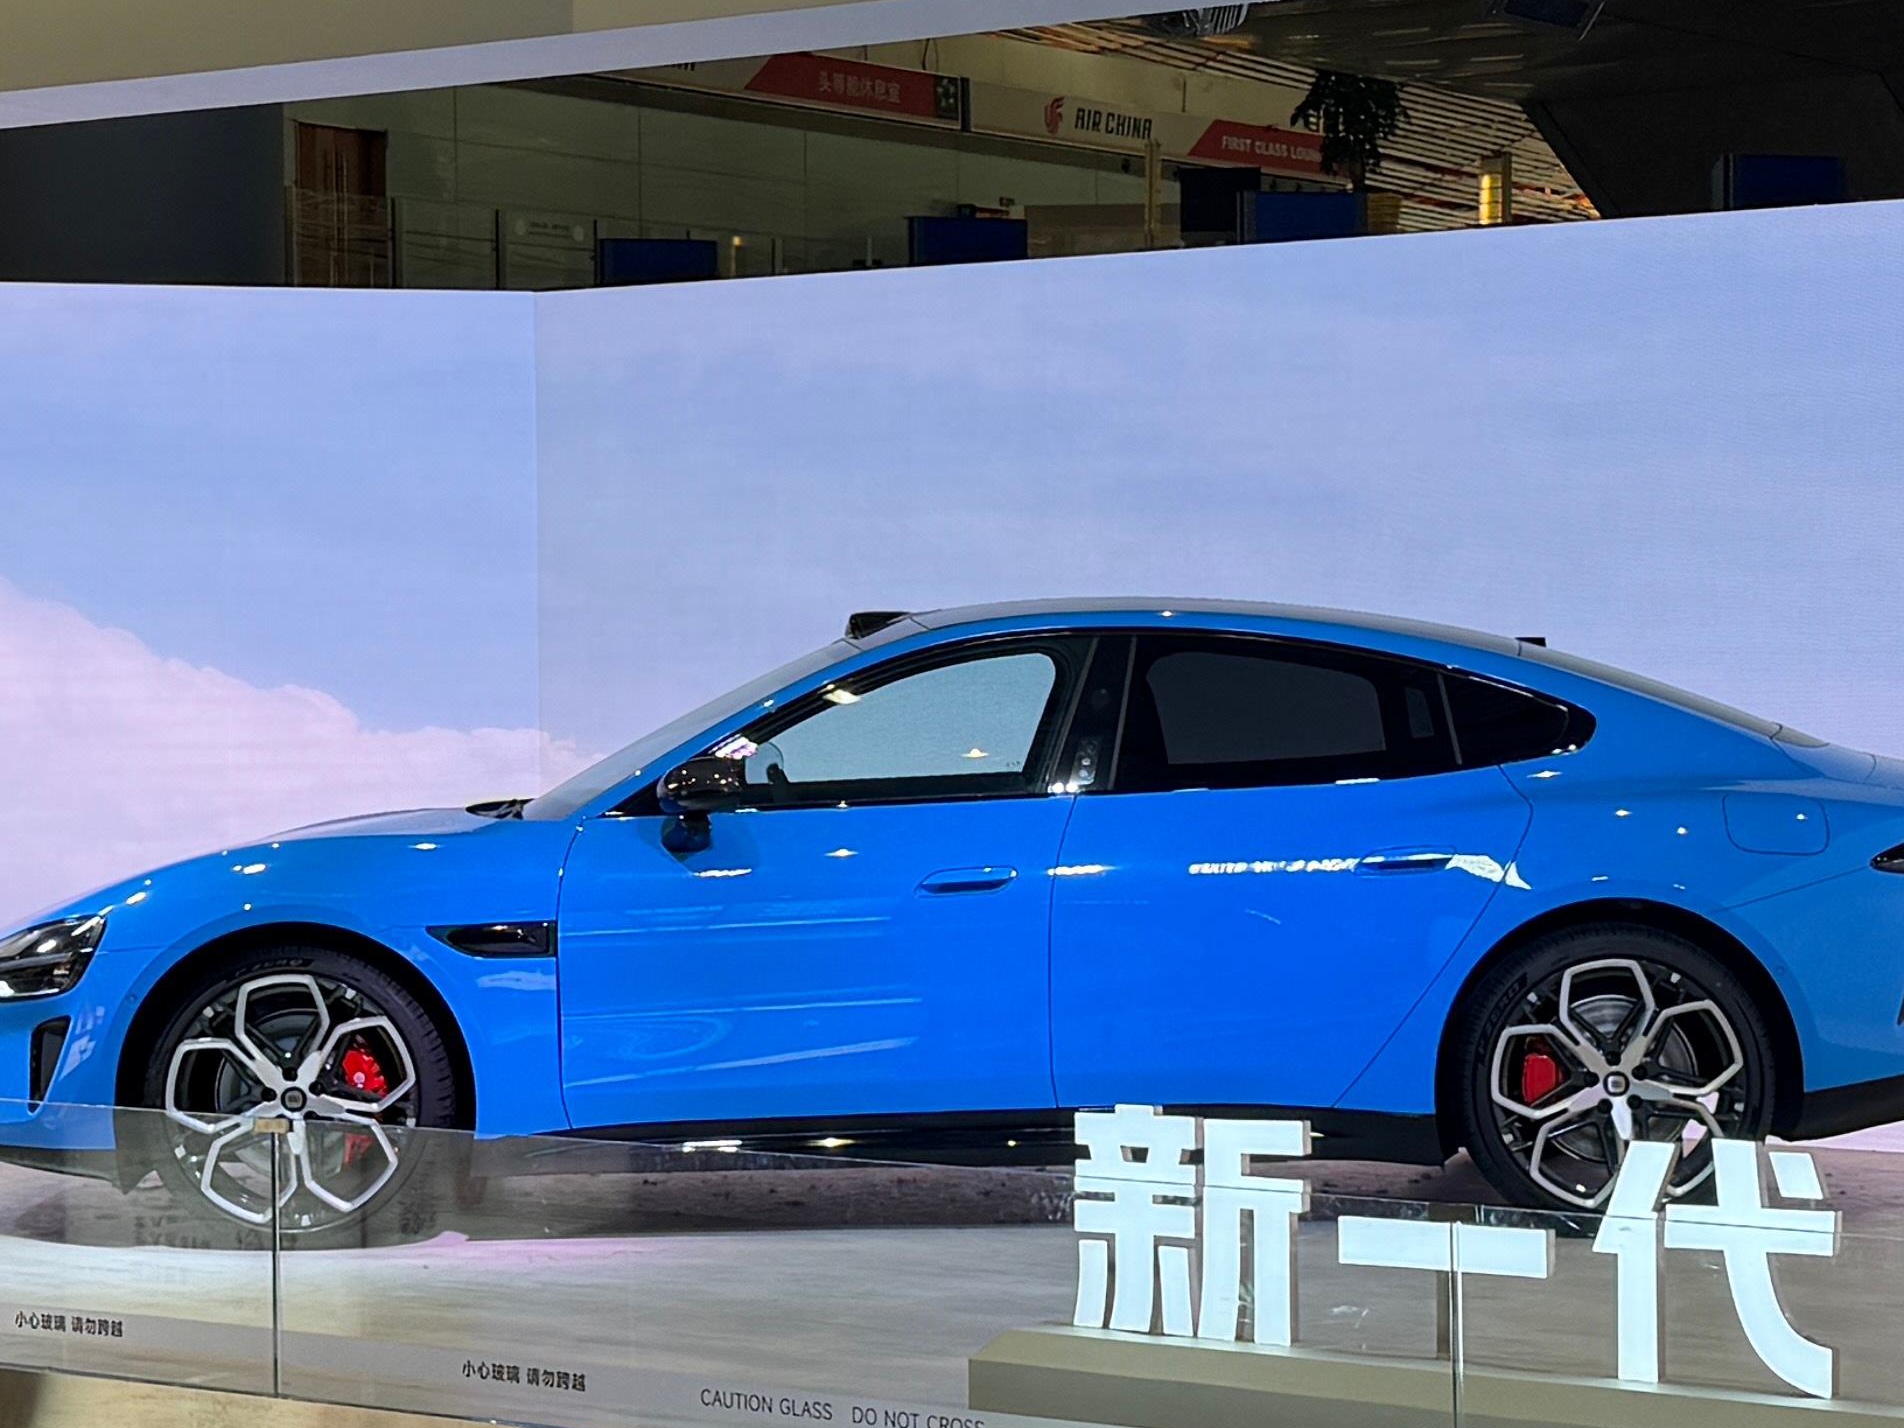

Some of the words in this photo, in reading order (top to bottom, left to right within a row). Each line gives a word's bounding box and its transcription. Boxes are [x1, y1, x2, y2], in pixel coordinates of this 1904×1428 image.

[1075, 108, 1101, 132] AIR
[1105, 113, 1153, 139] CHINA
[1221, 135, 1251, 153] FIRST
[1254, 140, 1288, 157] CLASS
[1071, 1104, 1843, 1400] 新一代
[15, 1309, 66, 1335] 小心玻璃
[71, 1315, 124, 1339] 请勿跨越
[461, 1359, 520, 1386] 小心玻璃
[527, 1366, 587, 1393] 请勿跨越
[699, 1388, 773, 1416] CAUTION
[779, 1396, 834, 1423] GLASS
[851, 1405, 878, 1427] DO
